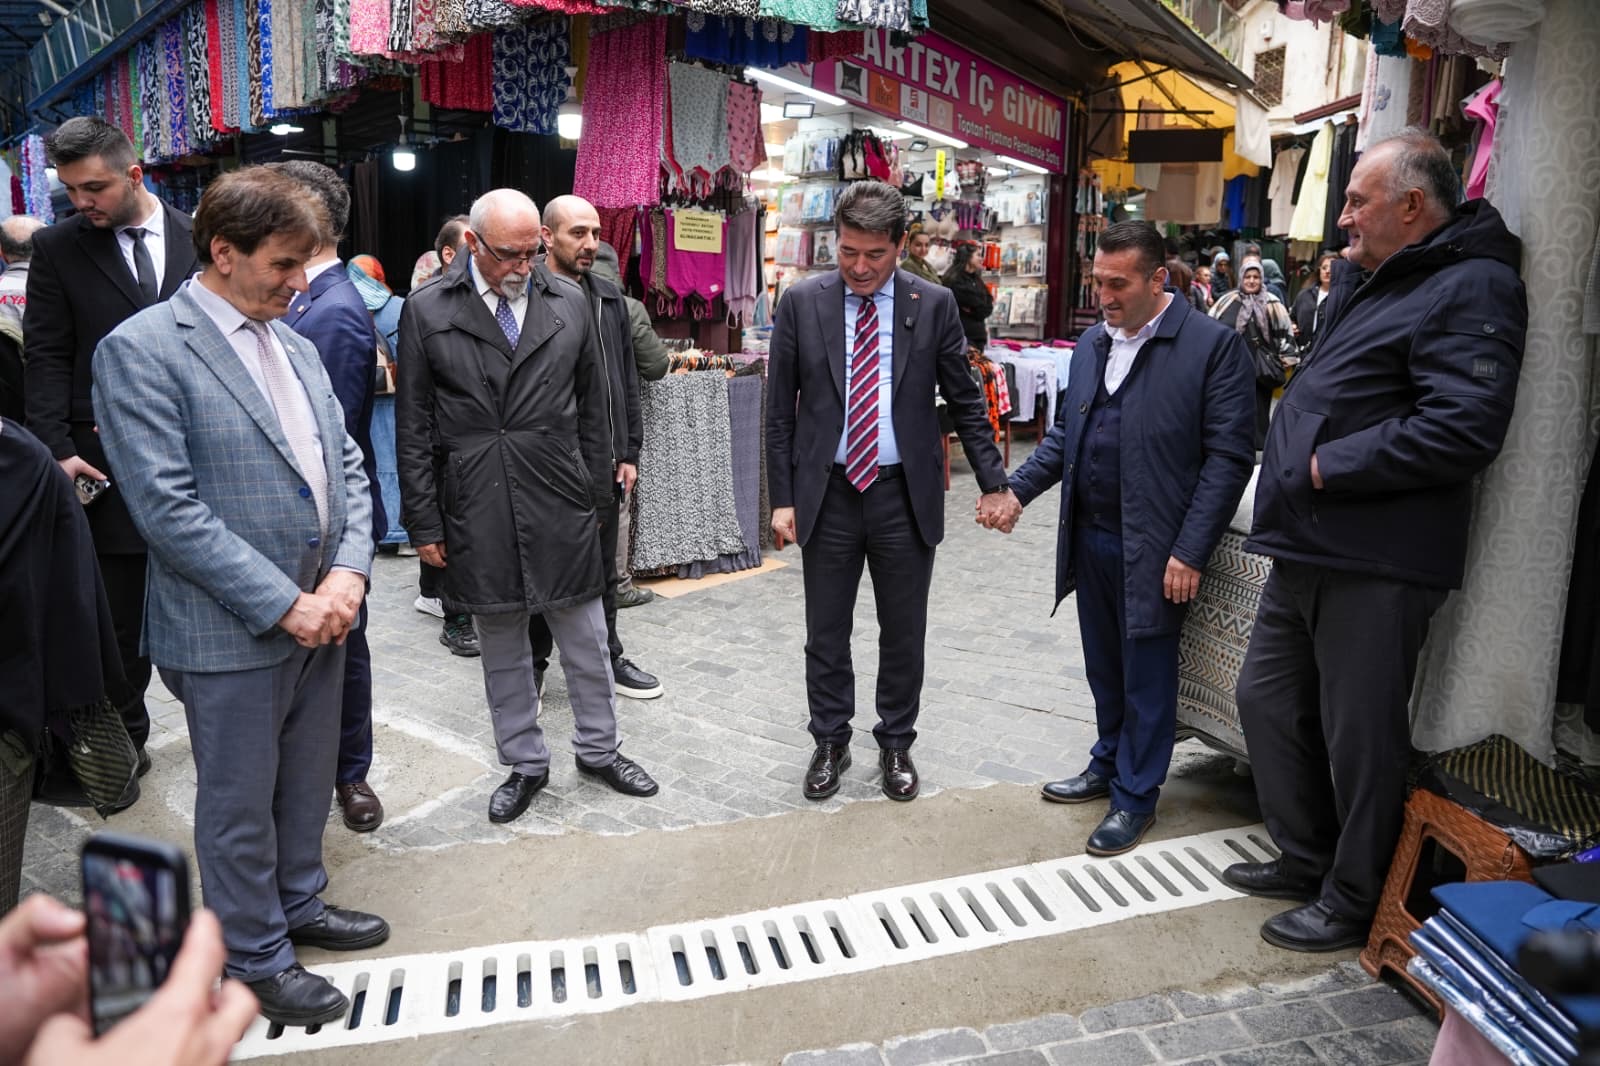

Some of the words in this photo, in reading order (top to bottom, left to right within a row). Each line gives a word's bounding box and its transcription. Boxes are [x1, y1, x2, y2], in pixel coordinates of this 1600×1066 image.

[853, 28, 960, 100] ARTEX
[968, 61, 995, 116] İÇ
[1003, 84, 1062, 141] GİYİM
[957, 113, 984, 138] Toptan
